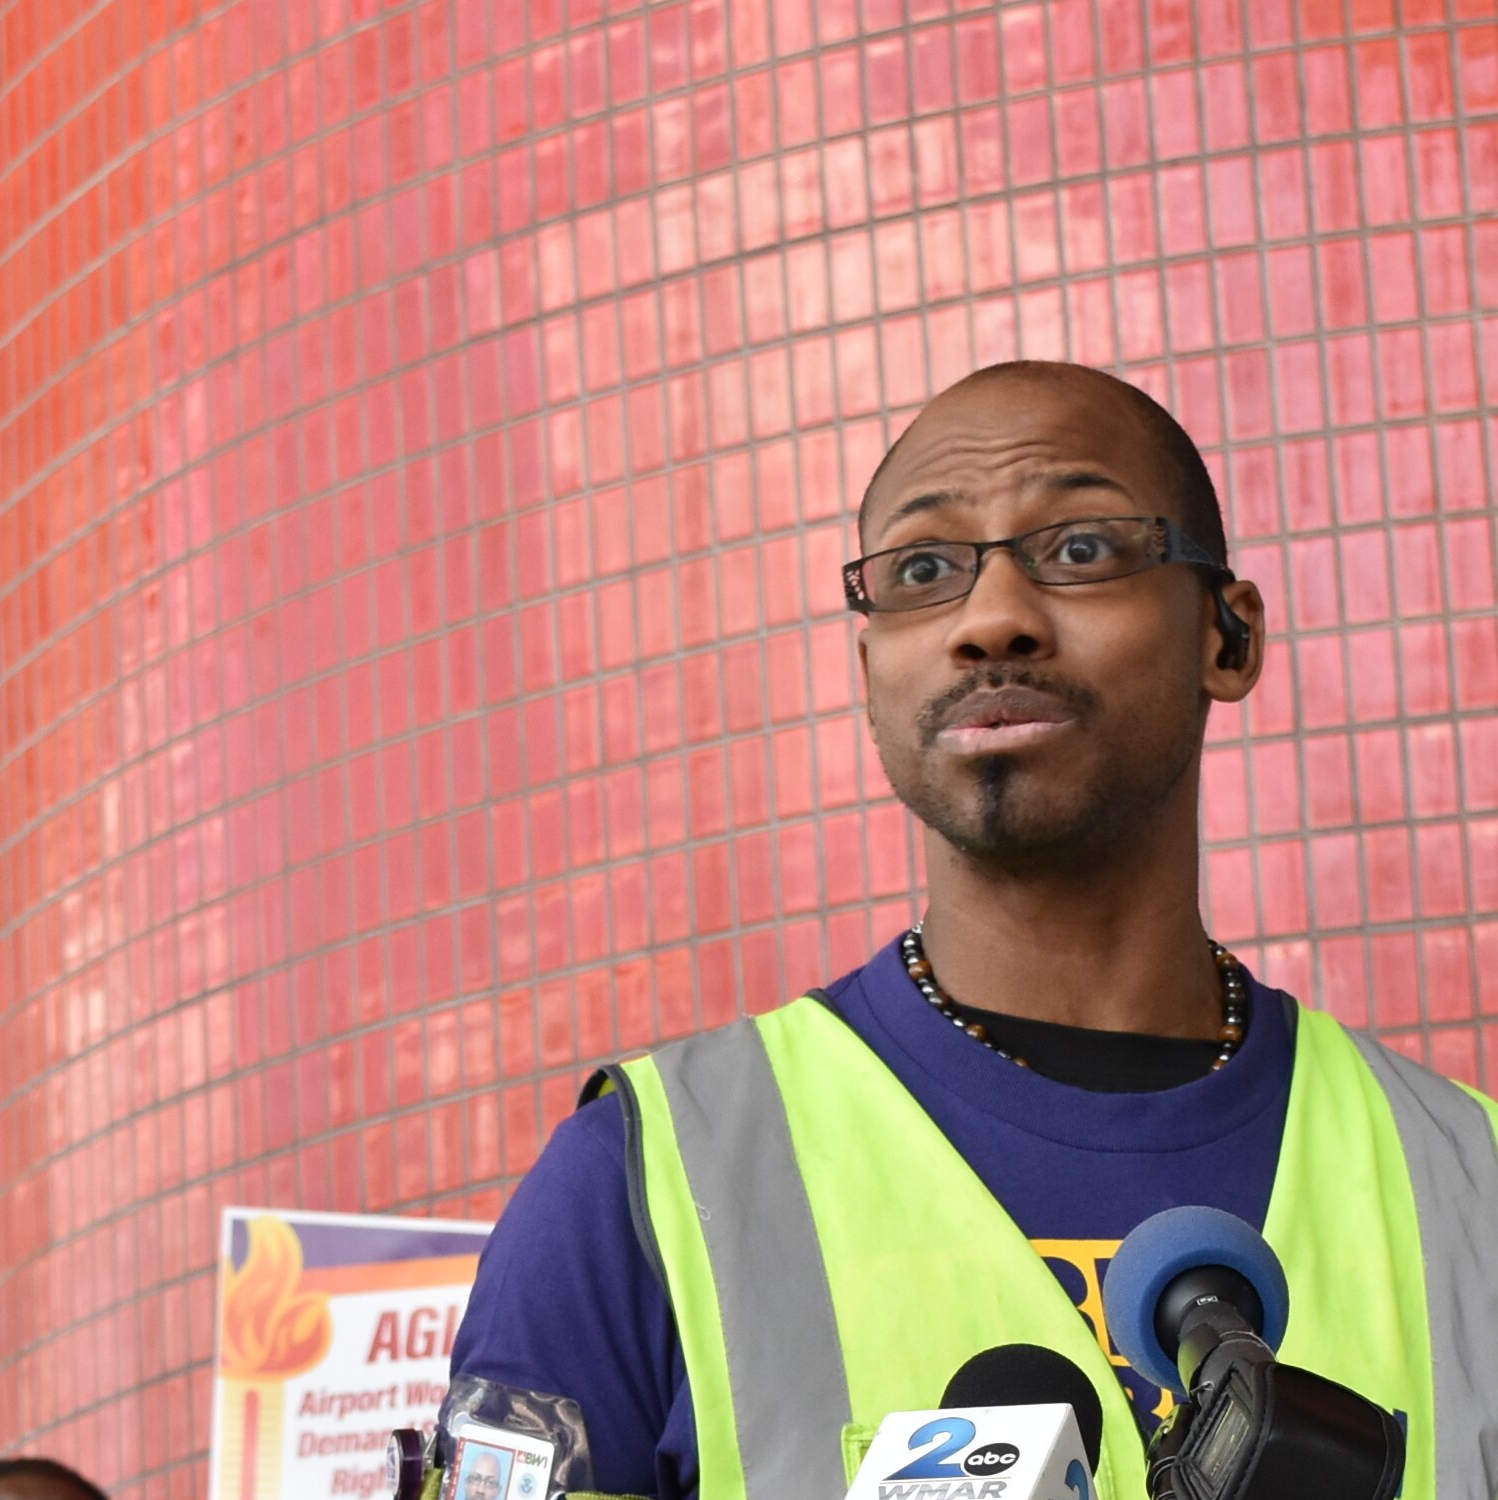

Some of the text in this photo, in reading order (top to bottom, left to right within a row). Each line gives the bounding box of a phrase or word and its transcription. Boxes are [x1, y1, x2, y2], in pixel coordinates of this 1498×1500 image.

[299, 1384, 399, 1420] Airport
[882, 1417, 1017, 1481] 2 abc
